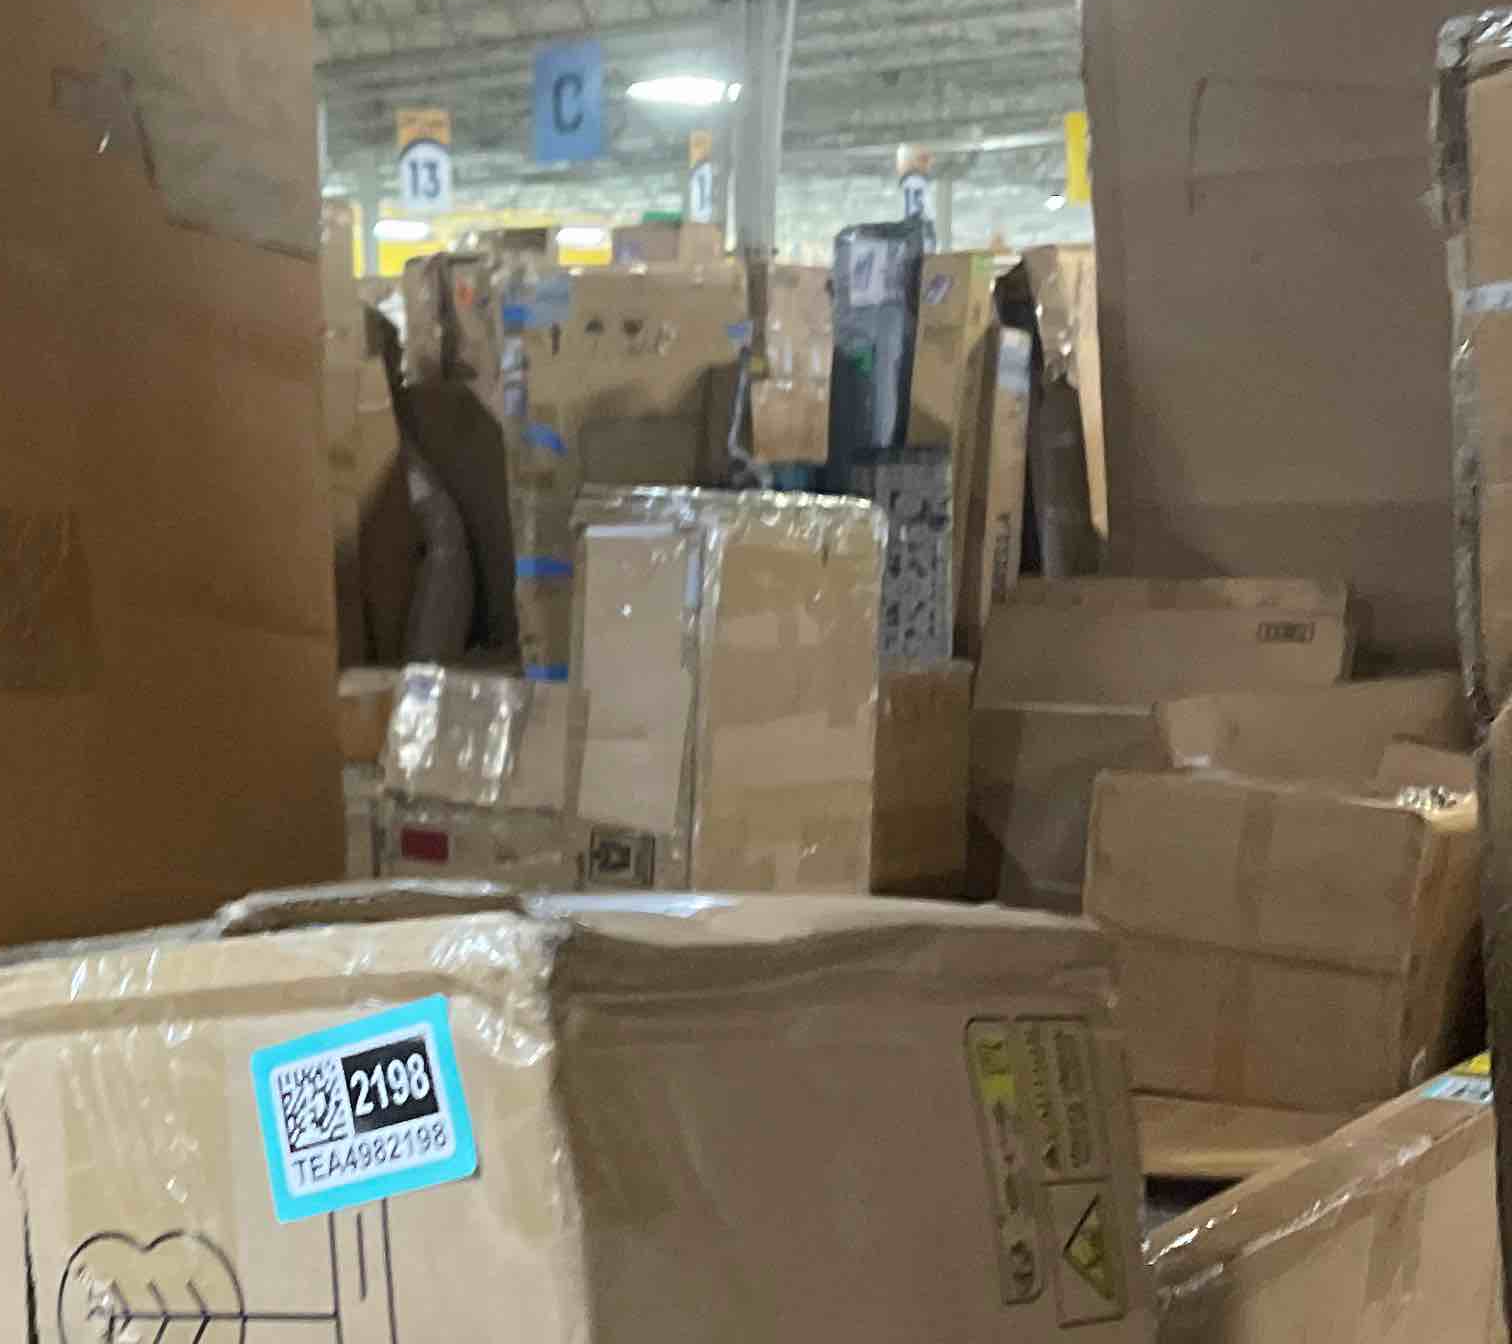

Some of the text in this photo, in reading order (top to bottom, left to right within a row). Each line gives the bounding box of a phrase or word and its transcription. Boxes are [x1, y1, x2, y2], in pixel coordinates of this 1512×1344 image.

[552, 73, 583, 134] C
[408, 160, 440, 198] 13
[349, 1052, 431, 1117] 2198
[291, 1120, 447, 1186] TEA4982198
